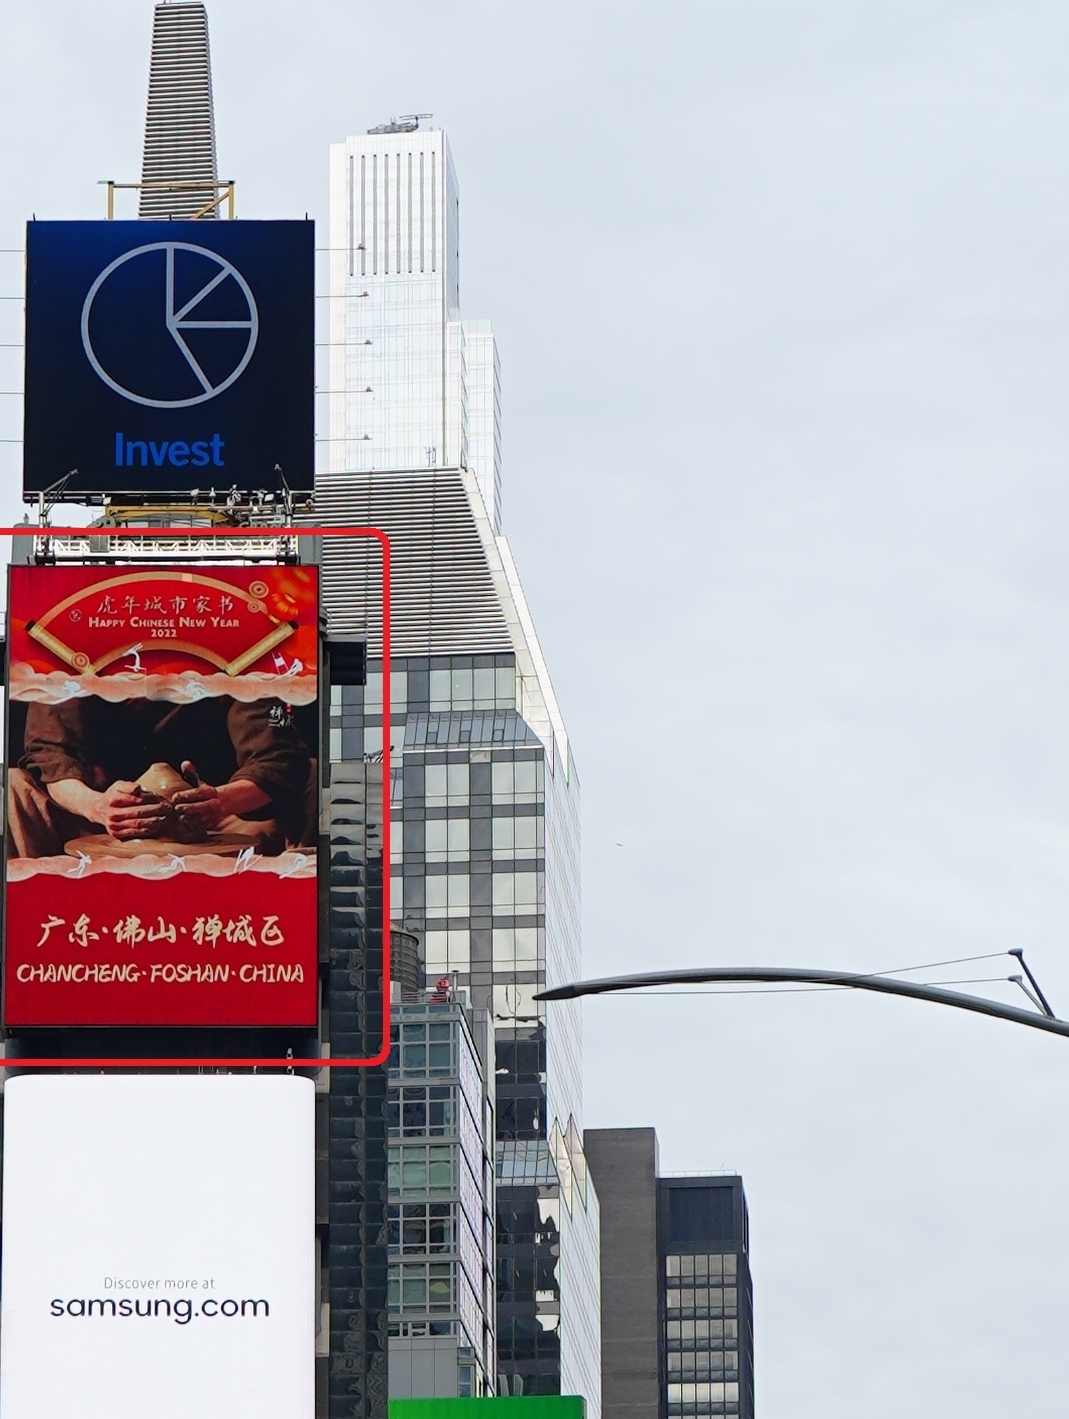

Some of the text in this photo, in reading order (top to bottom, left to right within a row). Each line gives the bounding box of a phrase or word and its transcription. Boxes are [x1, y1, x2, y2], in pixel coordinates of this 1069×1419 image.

[115, 432, 225, 467] Invest
[96, 594, 234, 616] 虎年城市家书
[88, 616, 240, 628] HAPPY CHINESE NEW YEAR
[150, 629, 178, 638] 2022
[104, 1277, 216, 1290] Discover more at
[50, 1299, 270, 1325] samsung.com
